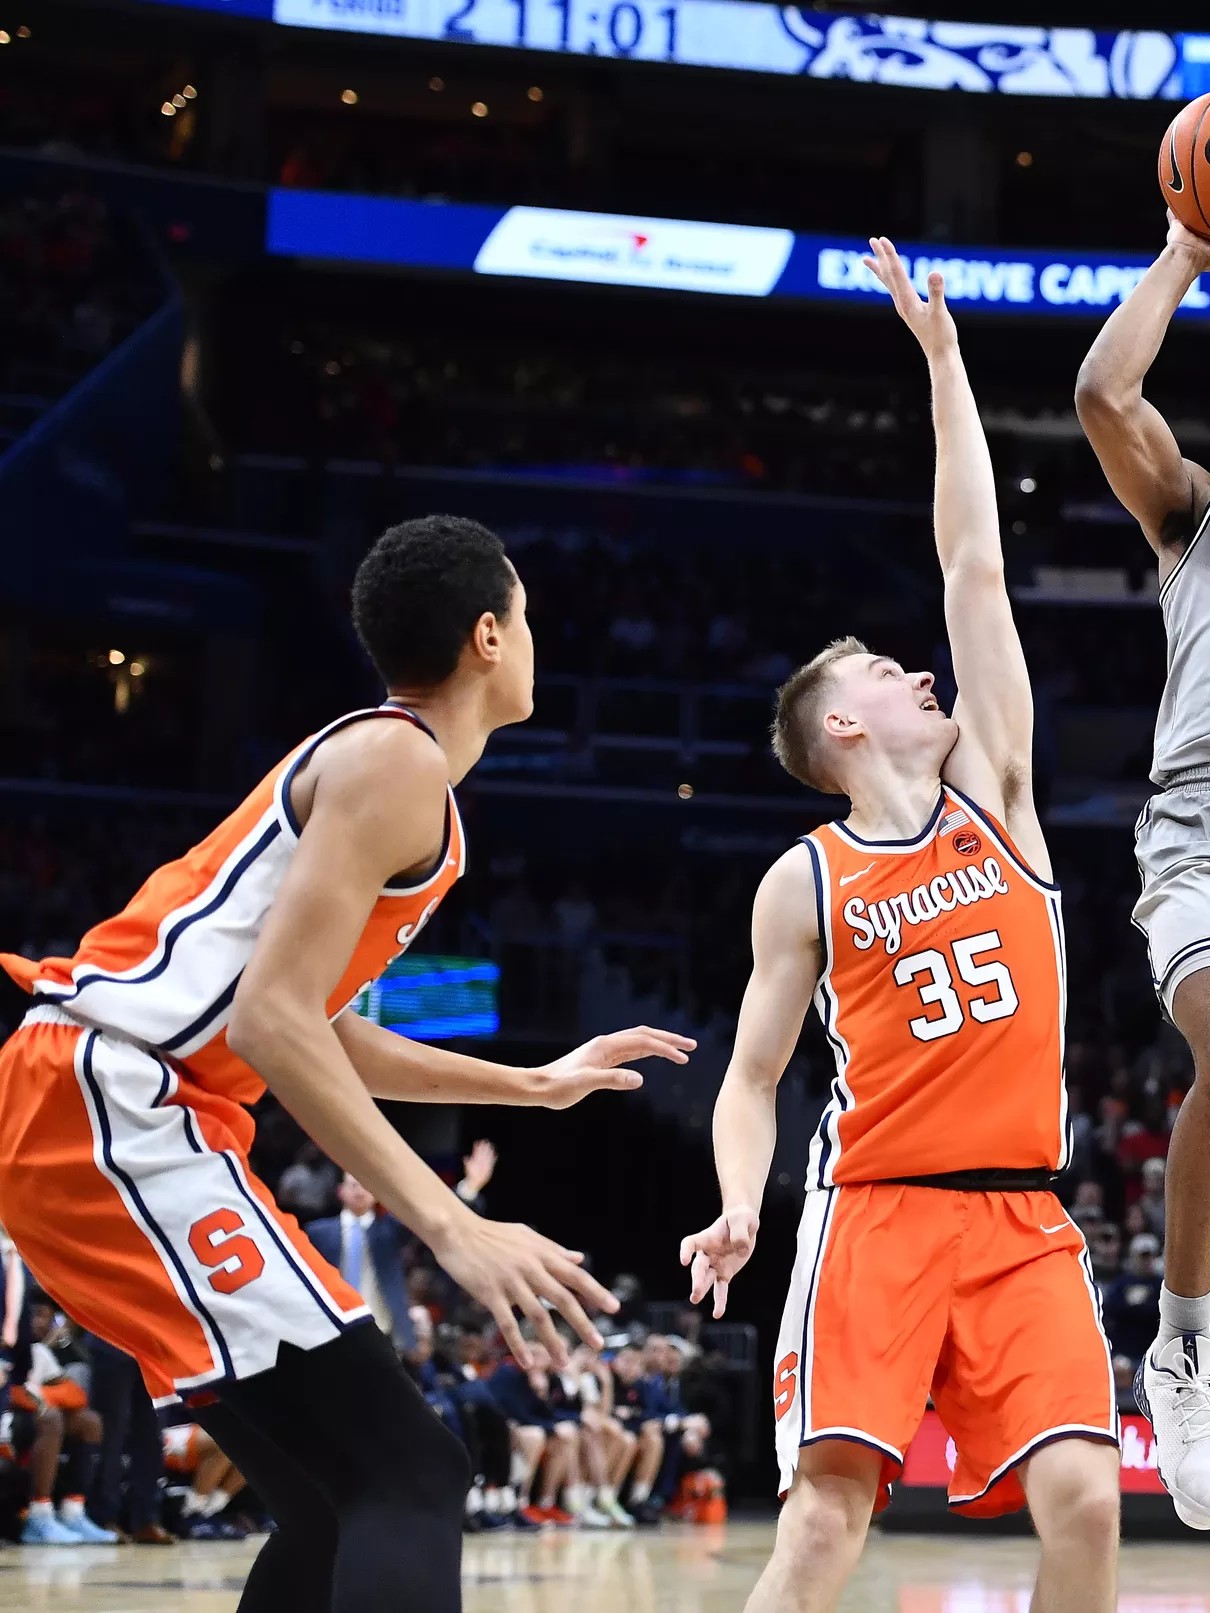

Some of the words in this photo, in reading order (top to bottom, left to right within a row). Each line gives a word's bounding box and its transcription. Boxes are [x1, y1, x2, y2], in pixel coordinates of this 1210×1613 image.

[510, 0, 678, 61] 11:01
[818, 248, 1034, 303] EXLUSIVE
[1039, 263, 1210, 309] CAPIL
[843, 857, 1009, 955] Syracuse
[893, 929, 1020, 1042] 35
[187, 1207, 265, 1295] S
[775, 1351, 798, 1422] S
